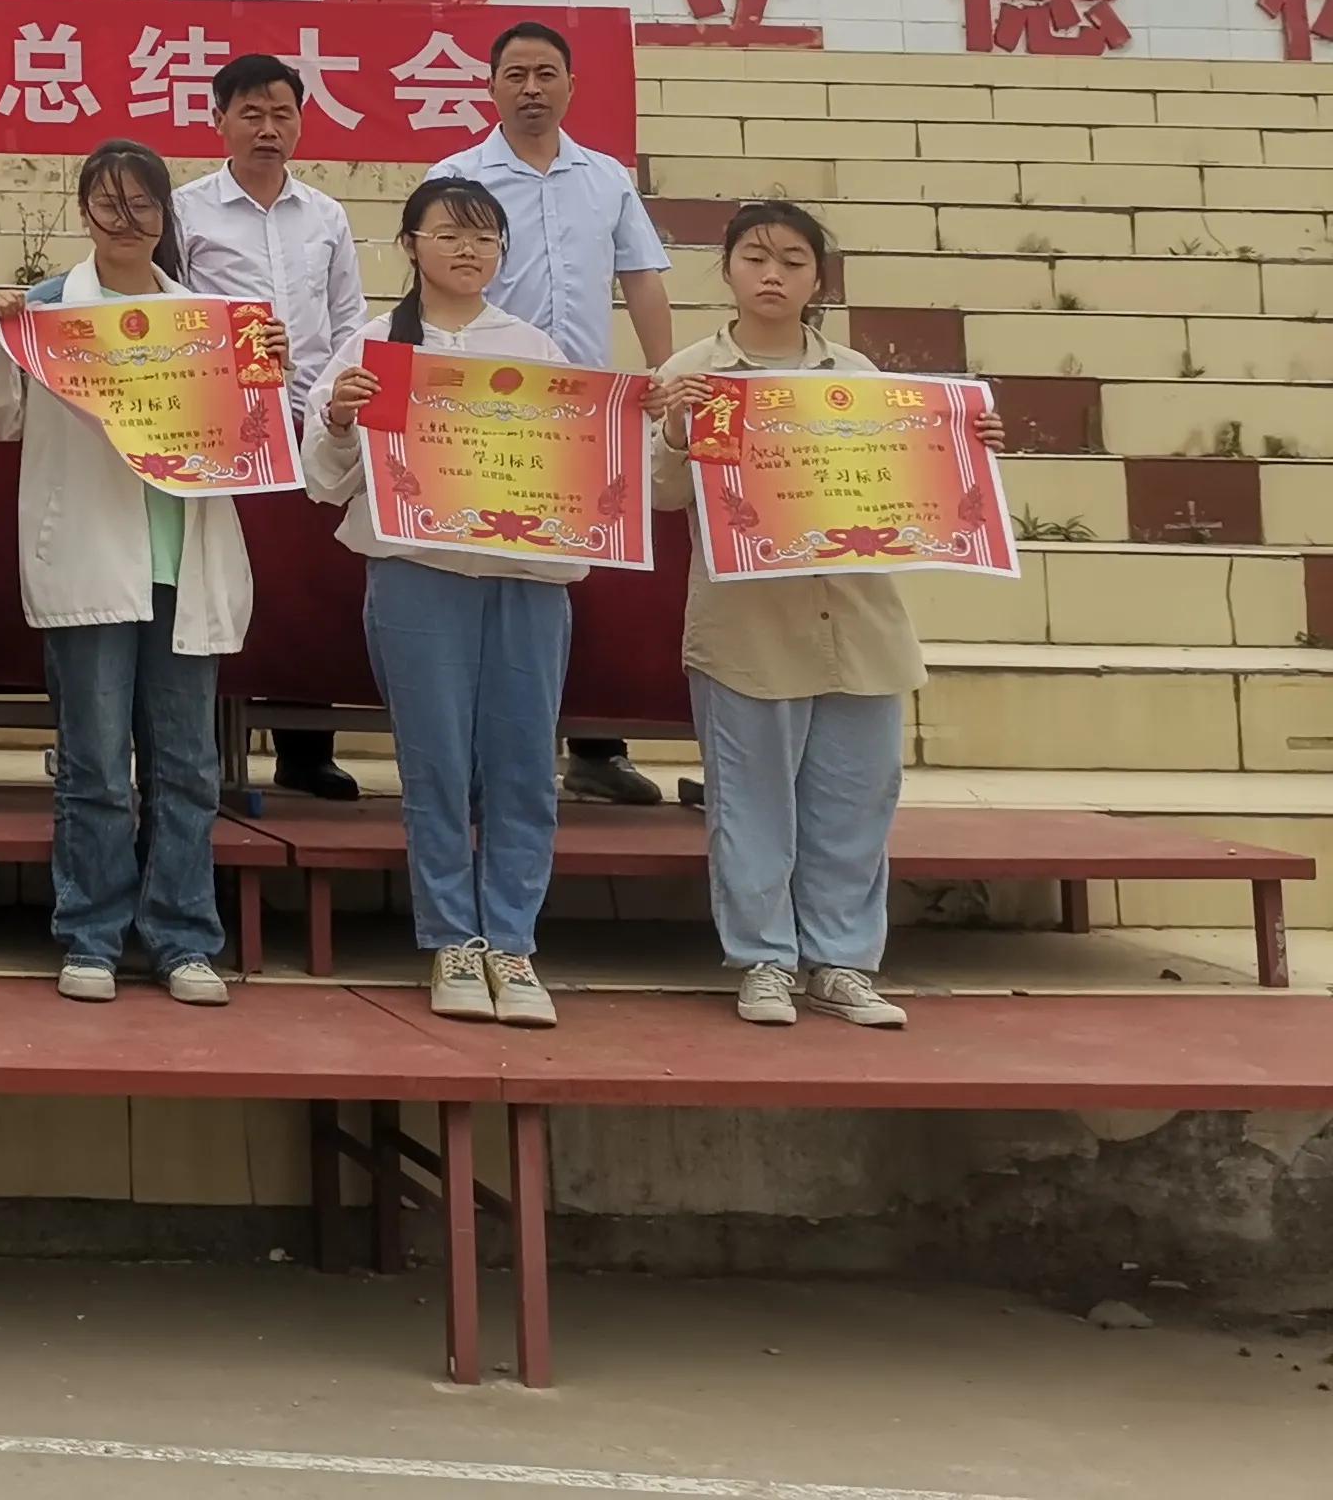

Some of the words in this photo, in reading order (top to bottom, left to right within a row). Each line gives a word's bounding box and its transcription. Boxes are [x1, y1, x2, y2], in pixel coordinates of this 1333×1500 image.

[109, 395, 181, 413] 学习标兵
[473, 451, 544, 469] 学习标兵
[813, 468, 892, 483] 学习标兵
